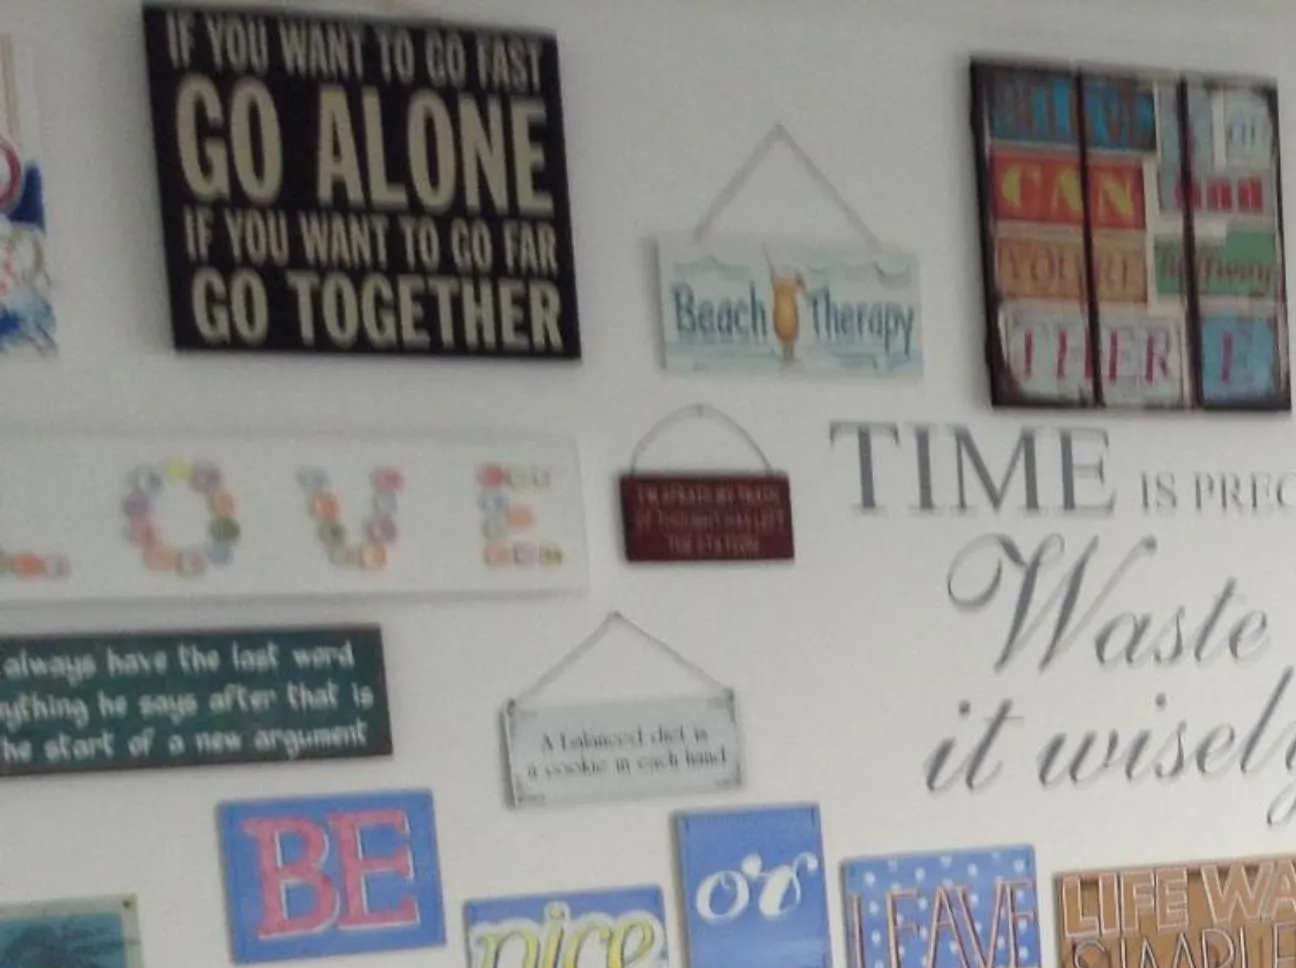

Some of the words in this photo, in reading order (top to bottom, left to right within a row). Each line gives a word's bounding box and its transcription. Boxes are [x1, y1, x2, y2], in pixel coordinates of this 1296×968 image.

[167, 13, 195, 69] IF
[206, 17, 268, 74] YOU
[279, 23, 365, 79] WANT
[380, 29, 413, 84] TO
[425, 31, 466, 87] GO
[476, 35, 543, 91] FAST
[175, 72, 283, 207] GO
[315, 83, 554, 217] ALONE
[1000, 163, 1135, 218] CAN
[183, 208, 210, 258] IF
[224, 211, 289, 260] YOU
[299, 214, 390, 269] WANT
[401, 218, 439, 270] TO
[452, 220, 492, 272] GO
[502, 223, 557, 274] FAR
[191, 268, 268, 344] GO
[285, 269, 563, 351] TOGETHER
[671, 280, 767, 340] Beach
[805, 285, 914, 361] Therapy
[829, 420, 1117, 518] TIME
[1140, 471, 1179, 514] IS
[0, 455, 565, 578] OVE
[947, 532, 1268, 674] Waste
[3, 648, 96, 686] always
[106, 646, 167, 677] have
[177, 643, 220, 674] the
[232, 640, 278, 671] last
[293, 640, 355, 668] word
[0, 690, 89, 731] ything
[97, 690, 128, 719] he
[139, 692, 198, 725] says
[209, 683, 277, 715] after
[287, 680, 339, 711] that
[352, 682, 374, 709] is
[44, 732, 114, 763] start
[128, 727, 155, 757] of
[168, 734, 185, 756] a
[196, 730, 242, 757] new
[254, 717, 367, 759] argument
[925, 699, 1023, 792] it
[241, 809, 420, 940] BE
[1062, 866, 1189, 938] LIFE
